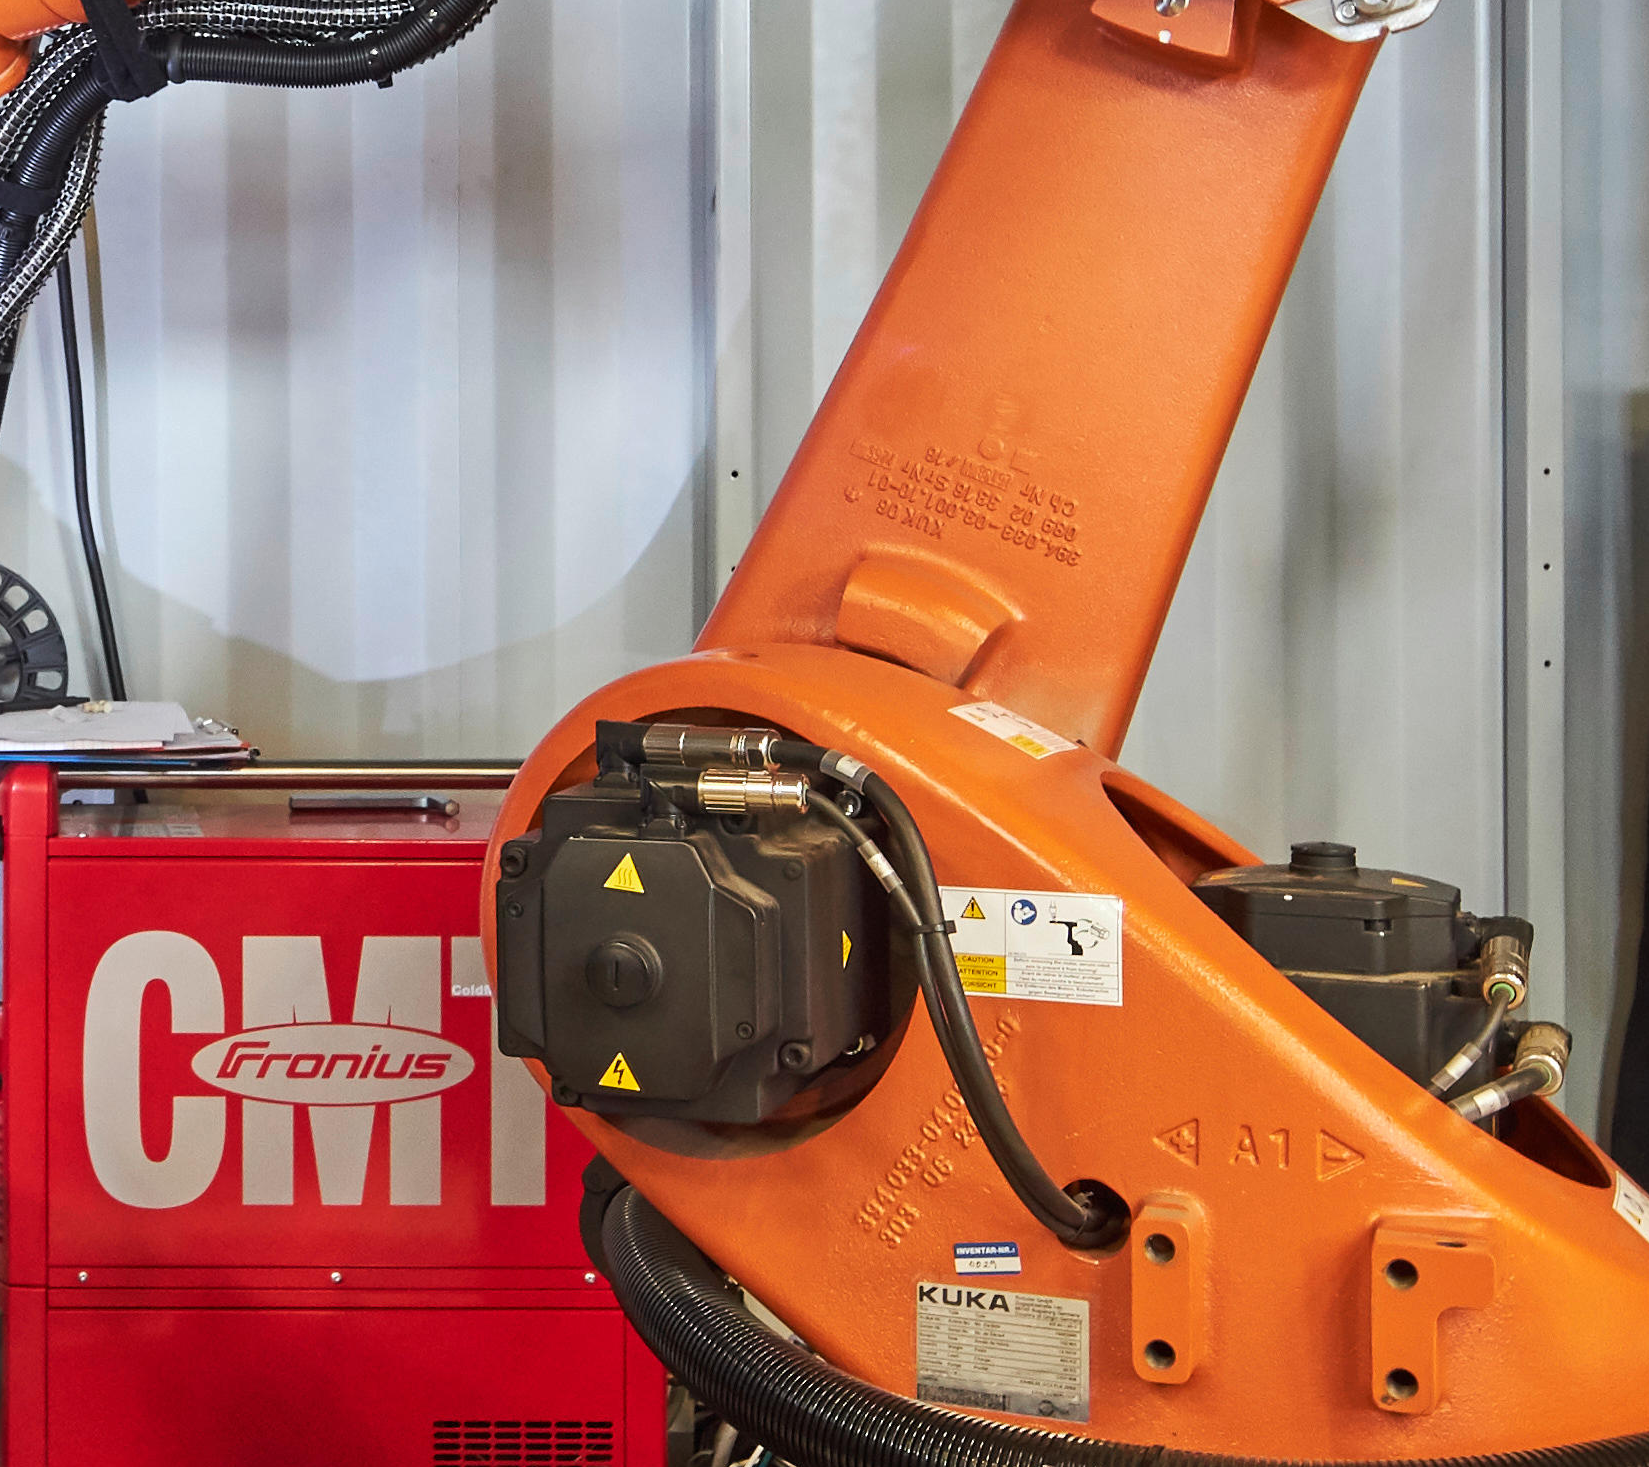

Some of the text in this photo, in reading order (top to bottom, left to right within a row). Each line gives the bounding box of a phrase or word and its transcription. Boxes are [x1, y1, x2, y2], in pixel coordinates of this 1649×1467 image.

[958, 968, 999, 978] ATTENTION
[961, 955, 995, 965] CAUTION
[82, 930, 547, 1209] CMT
[217, 1039, 453, 1082] Fronius
[1228, 1123, 1292, 1171] A1
[918, 1285, 1011, 1313] KUKA
